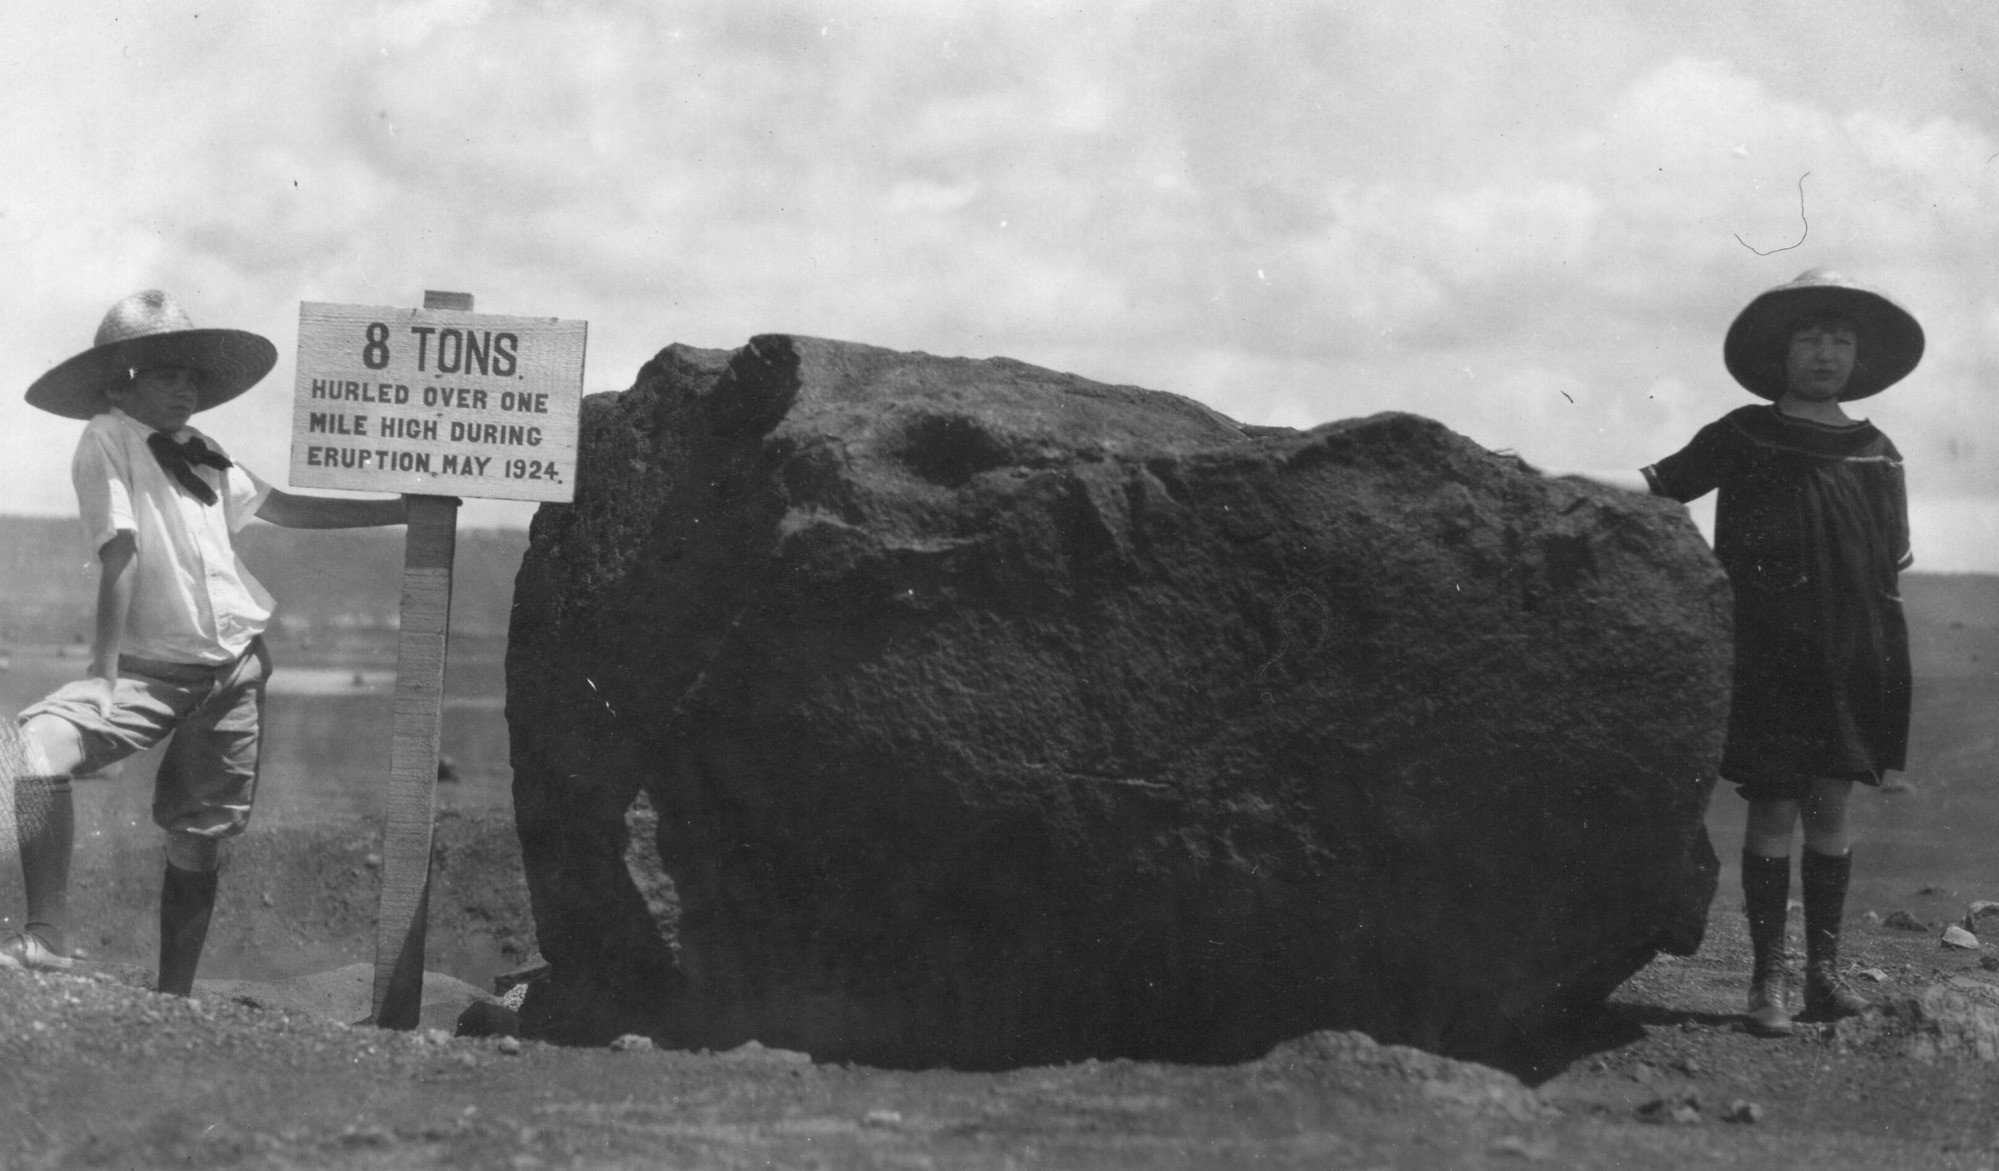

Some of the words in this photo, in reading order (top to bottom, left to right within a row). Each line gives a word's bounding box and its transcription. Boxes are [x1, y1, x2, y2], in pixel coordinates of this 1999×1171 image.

[362, 322, 391, 371] 8
[309, 378, 410, 407] HURLED
[423, 386, 489, 410] OVER
[500, 391, 550, 415] ONE
[309, 411, 368, 436] MILE
[380, 417, 439, 440] HIGH
[450, 421, 543, 448] DURING
[442, 454, 493, 478] MAY
[505, 459, 563, 485] 1924.
